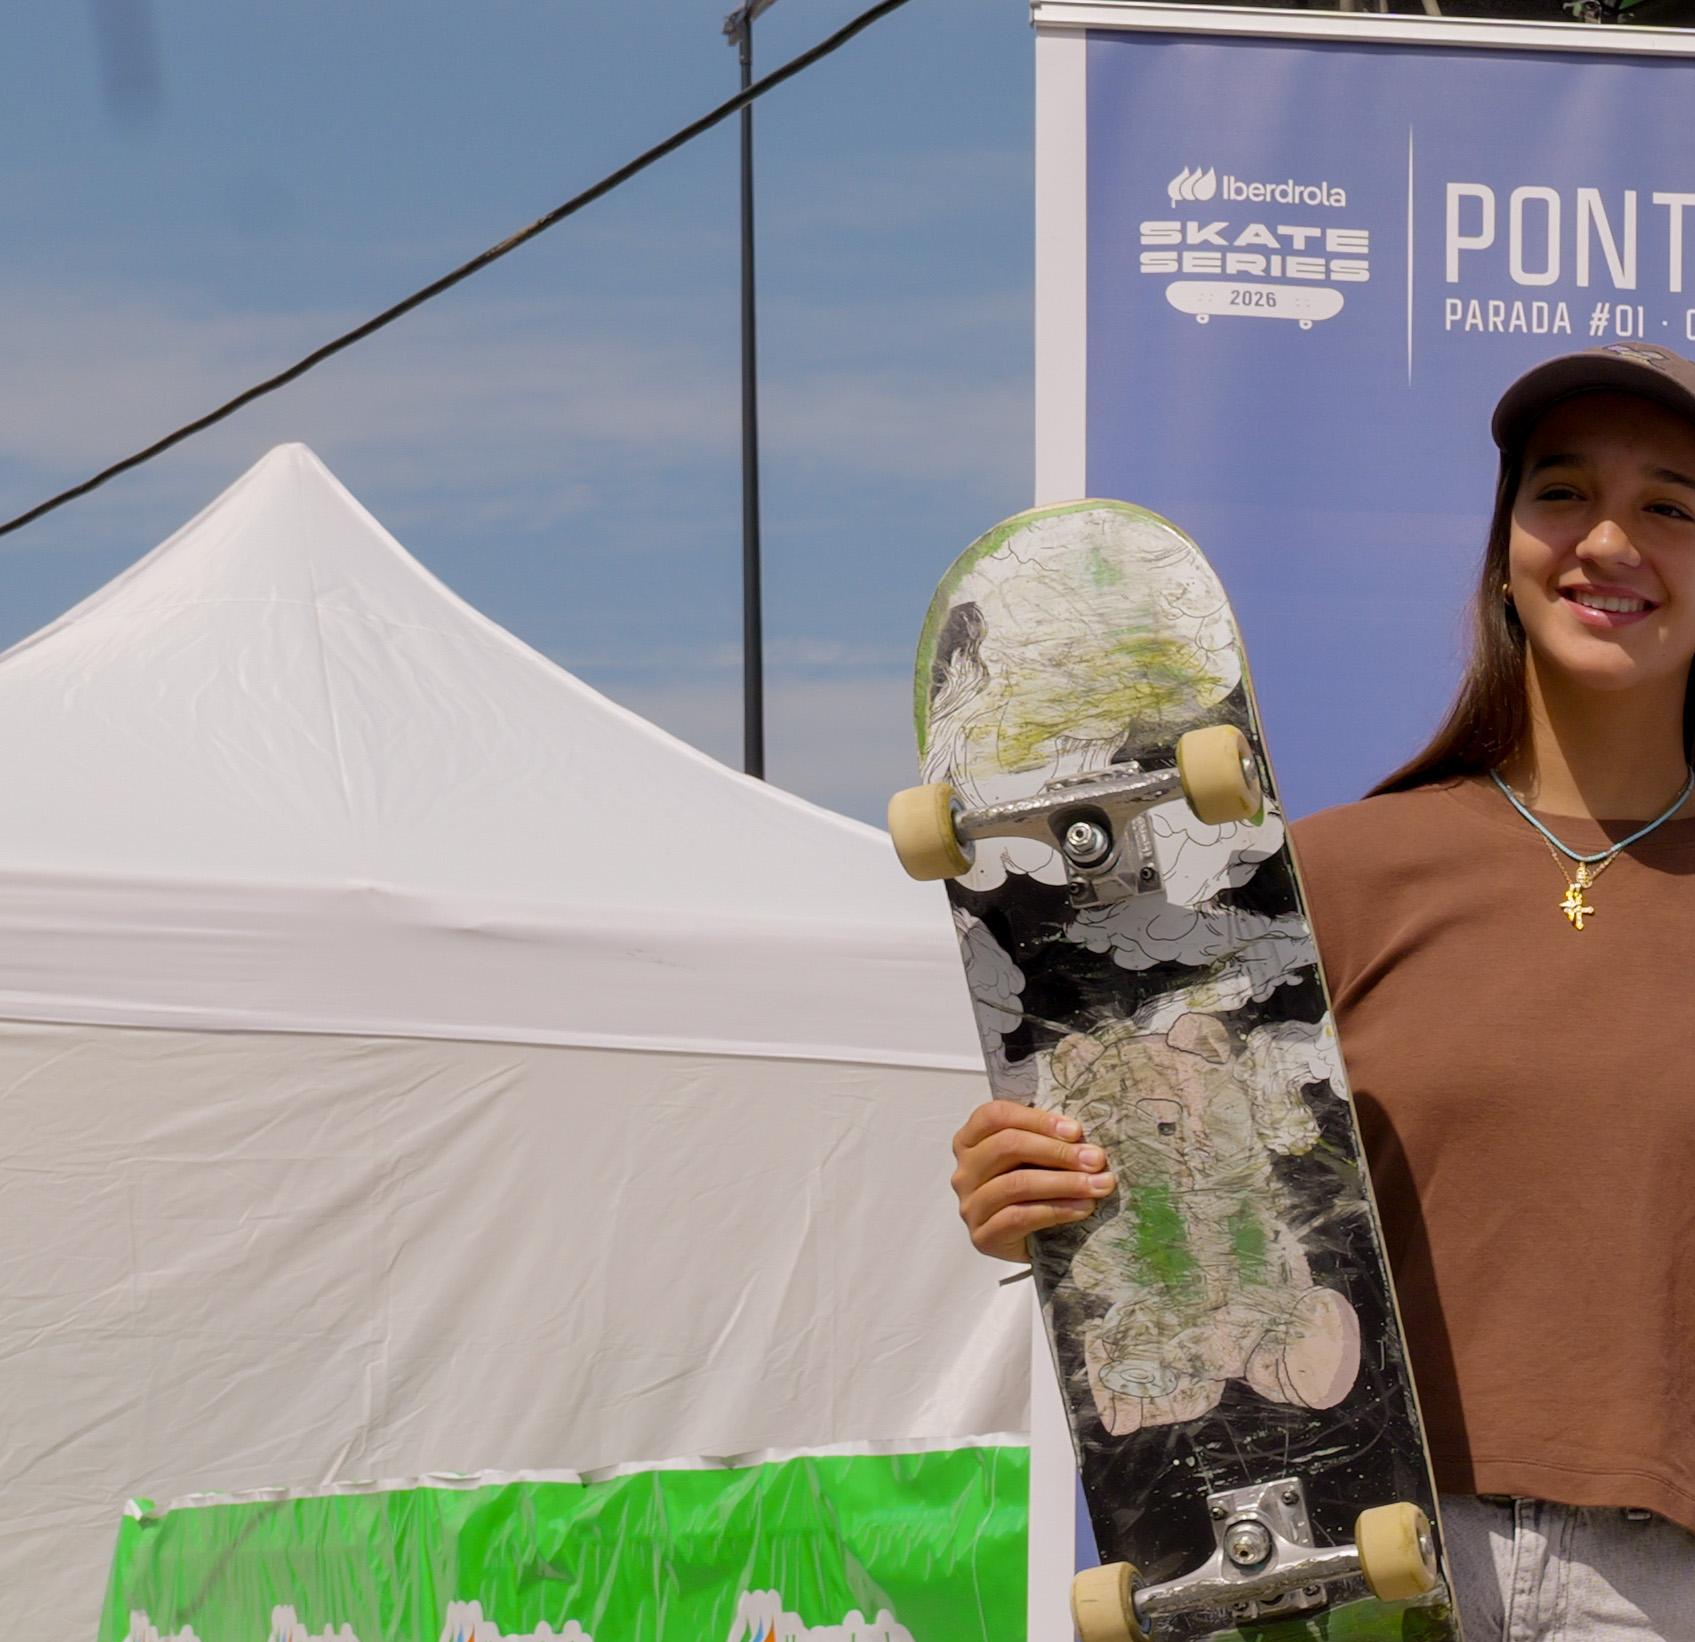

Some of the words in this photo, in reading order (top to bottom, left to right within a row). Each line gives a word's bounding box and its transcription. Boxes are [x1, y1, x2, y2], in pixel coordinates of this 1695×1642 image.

[1222, 175, 1346, 207] Iberdrola
[1139, 221, 1369, 254] SKATE
[1139, 251, 1370, 282] SERIES
[1230, 289, 1277, 308] 2026
[1444, 298, 1572, 334] PARADA
[1588, 302, 1645, 338] #01
